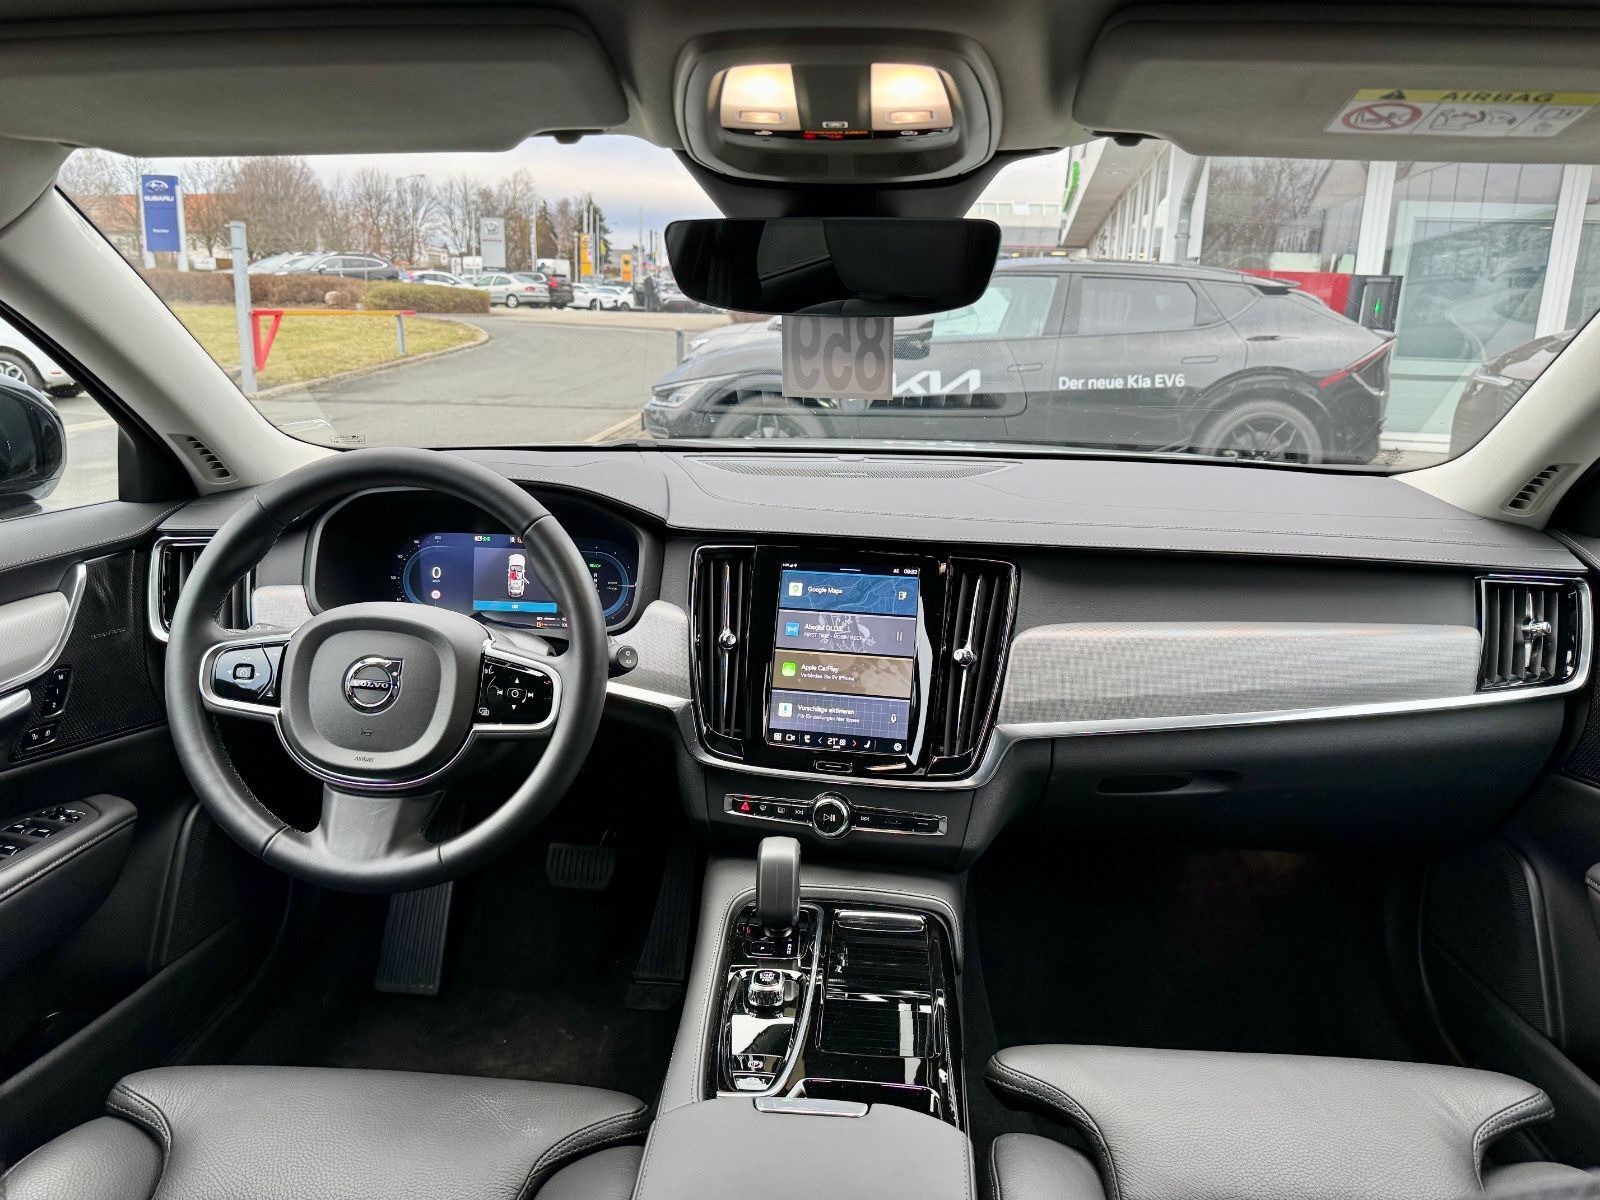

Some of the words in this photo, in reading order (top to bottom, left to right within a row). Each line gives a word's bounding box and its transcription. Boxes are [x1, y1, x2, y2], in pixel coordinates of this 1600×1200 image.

[1441, 91, 1555, 102] AIRBAG
[1058, 376, 1085, 390] Der
[1087, 377, 1124, 390] neue
[1127, 374, 1152, 389] Kia
[1154, 373, 1185, 388] EV6
[432, 566, 442, 579] 0
[807, 585, 828, 595] Google
[828, 587, 843, 595] Maps
[800, 664, 817, 672] Apple
[817, 665, 840, 674] CarPlay
[353, 681, 389, 689] VOLVO
